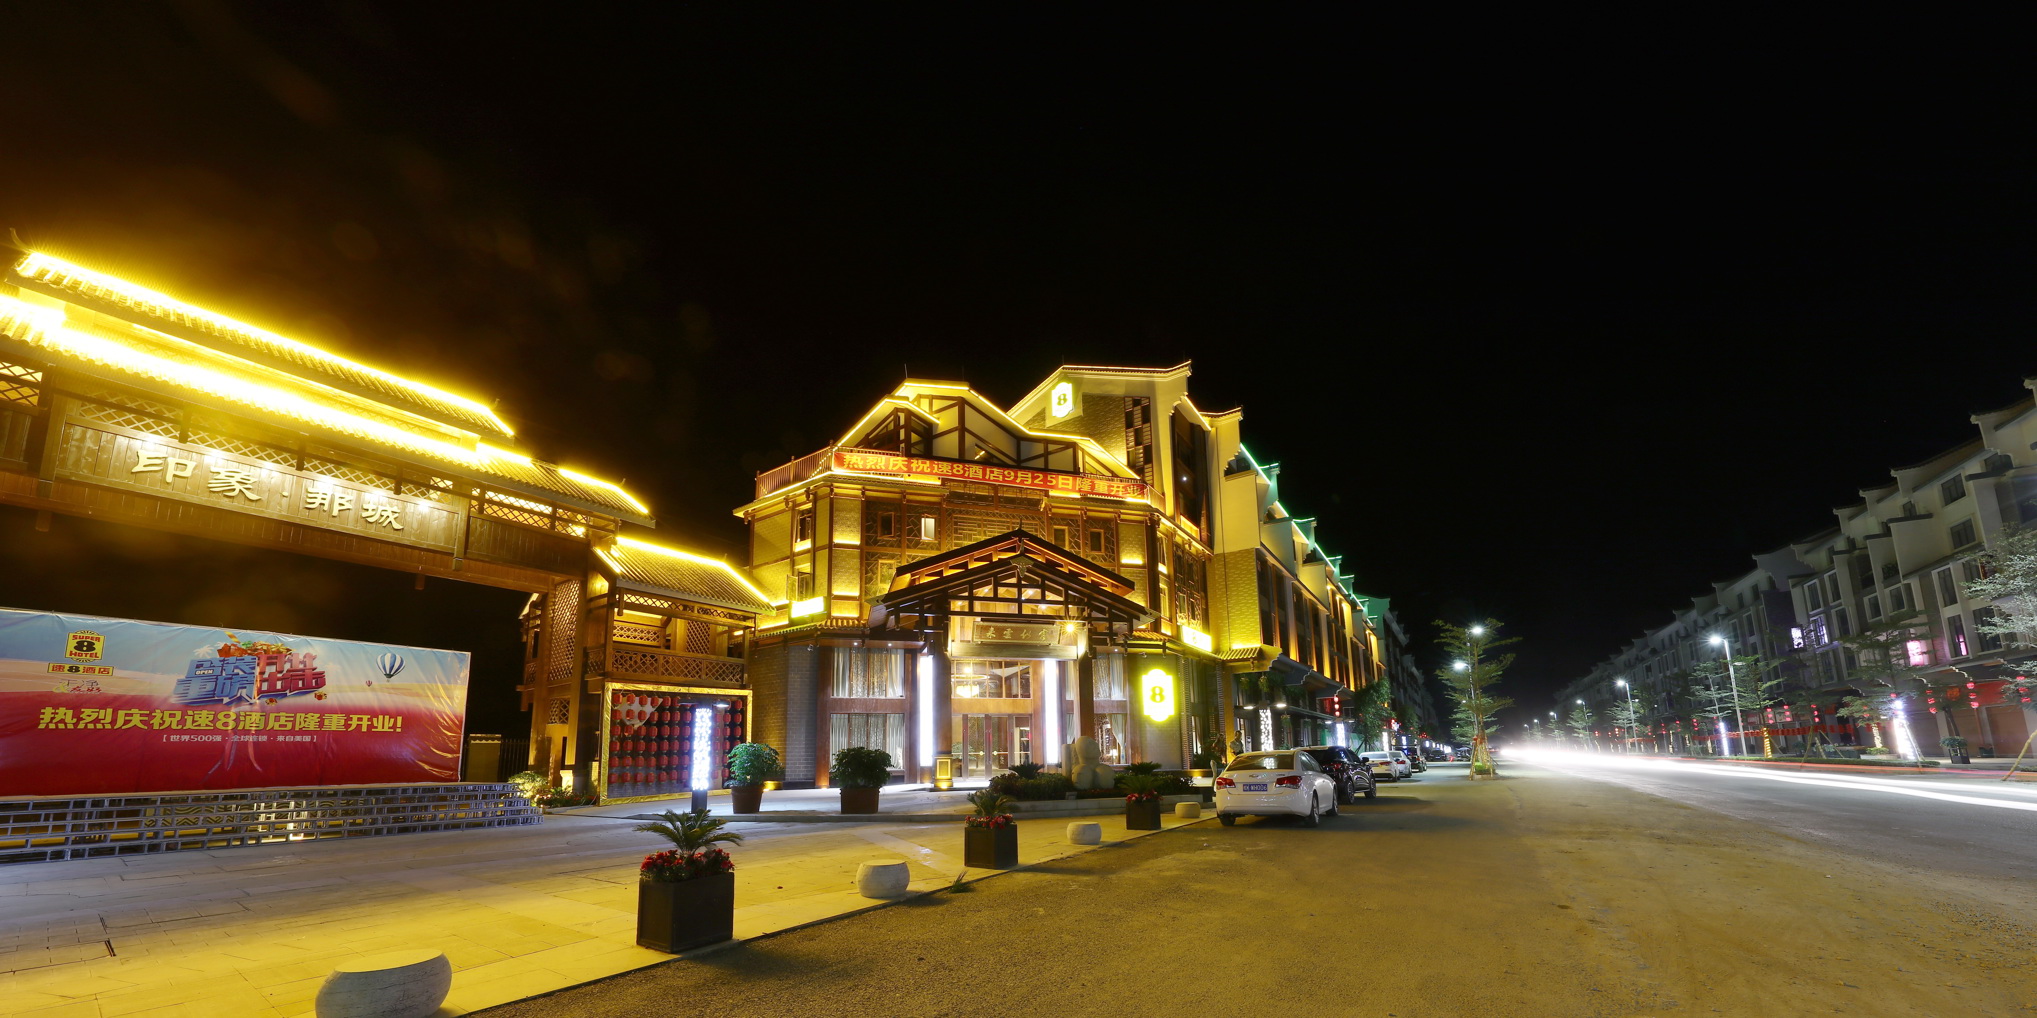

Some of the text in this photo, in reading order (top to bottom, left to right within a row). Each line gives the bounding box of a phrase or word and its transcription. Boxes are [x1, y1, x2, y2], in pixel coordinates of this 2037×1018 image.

[843, 454, 1146, 497] 热烈庆祝速8酒店9月25日隆重开业
[72, 634, 101, 642] SUPER
[73, 640, 96, 652] 8
[69, 650, 100, 658] HOTEL
[51, 664, 111, 674] 速8酒店
[1150, 686, 1166, 703] 8
[37, 707, 403, 733] 热烈庆祝速8酒店隆重开业!
